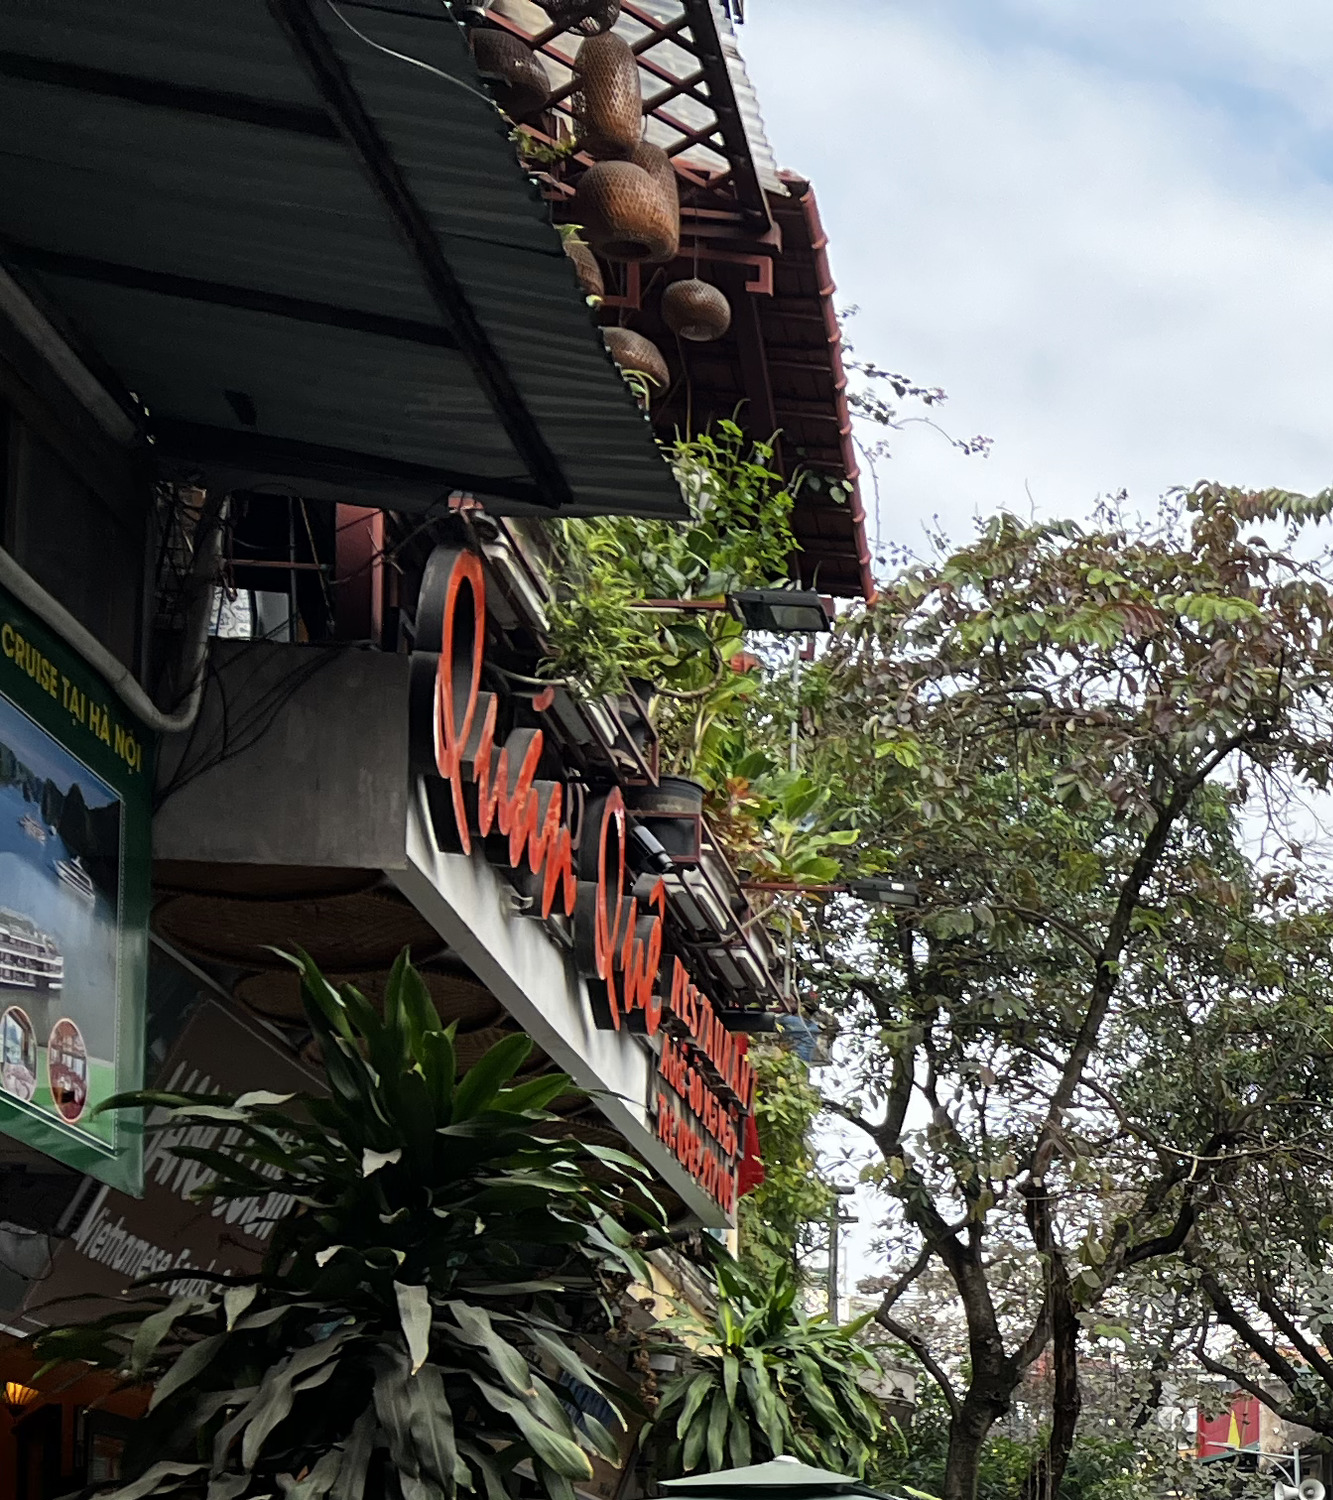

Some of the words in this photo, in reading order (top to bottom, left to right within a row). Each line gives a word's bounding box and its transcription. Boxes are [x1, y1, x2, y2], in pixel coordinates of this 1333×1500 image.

[2, 622, 58, 699] CRUISE
[61, 676, 86, 726] TẠI
[89, 702, 111, 746] HÀ
[115, 723, 142, 775] NỘI
[75, 1206, 173, 1283] Vietnamese
